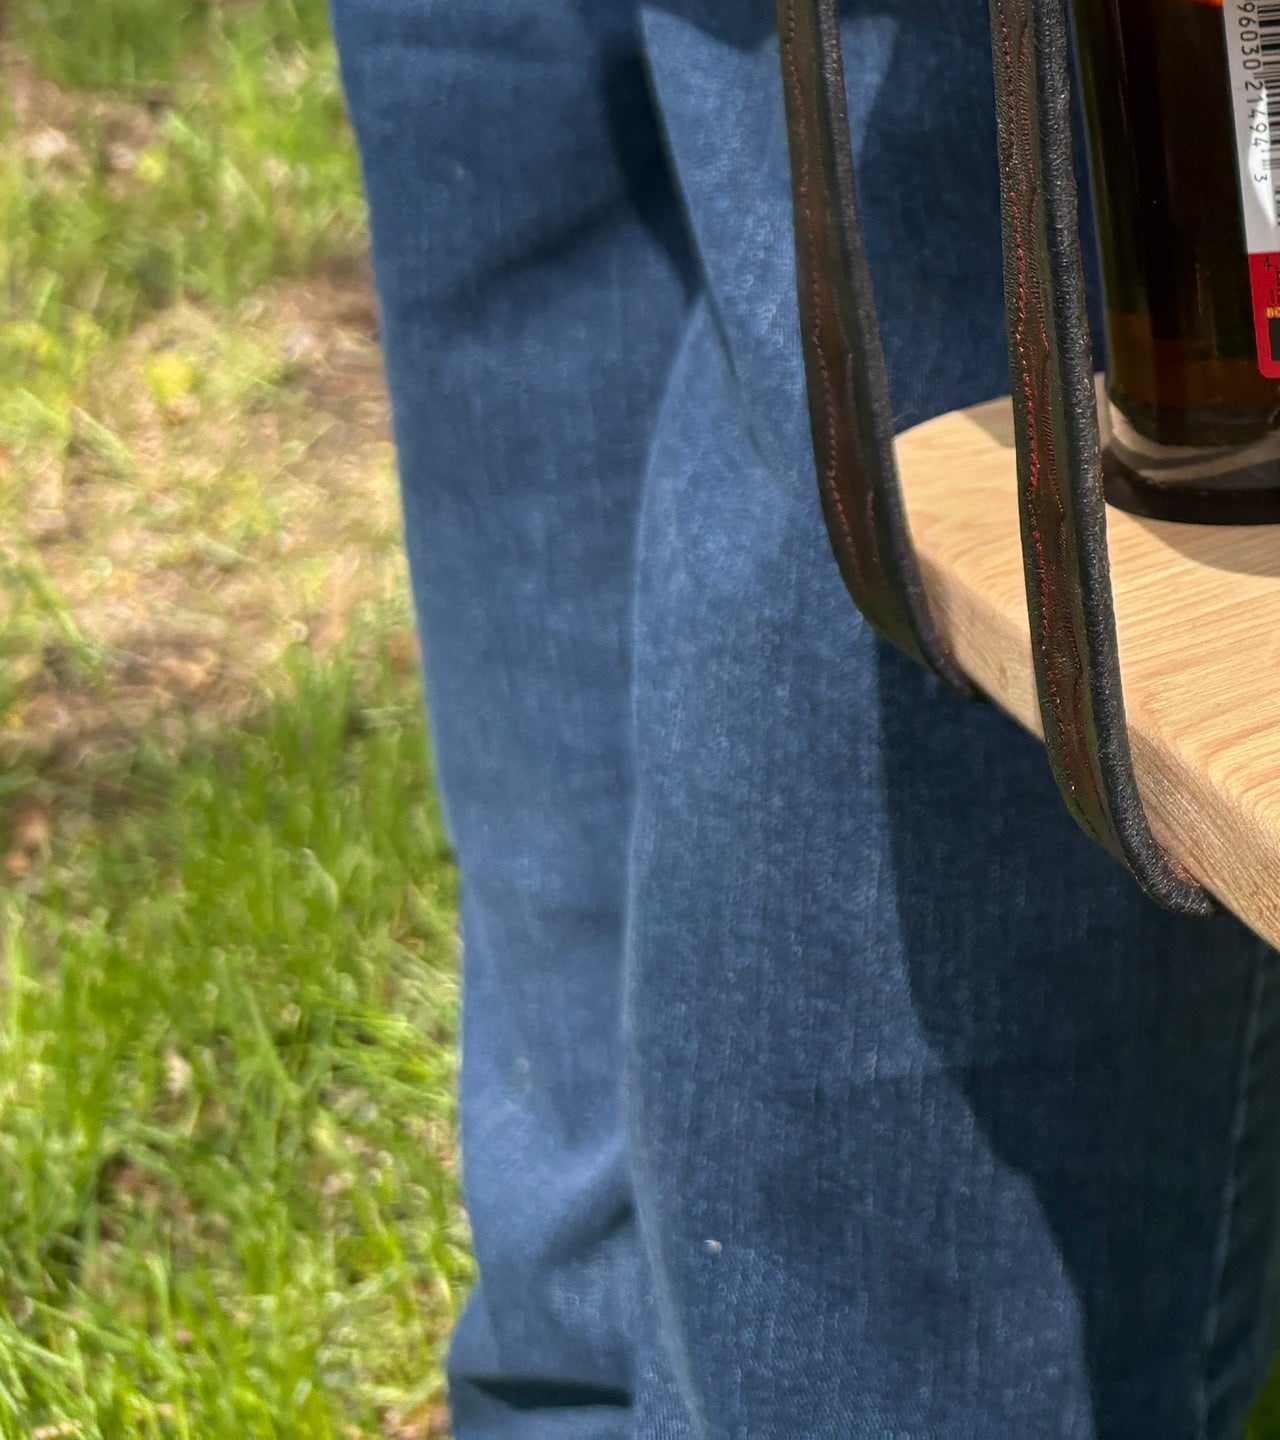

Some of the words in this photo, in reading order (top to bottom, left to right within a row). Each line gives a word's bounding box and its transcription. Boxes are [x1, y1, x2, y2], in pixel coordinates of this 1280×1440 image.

[1237, 2, 1261, 69] 96030
[1245, 81, 1268, 147] 21494
[1254, 173, 1267, 182] 3
